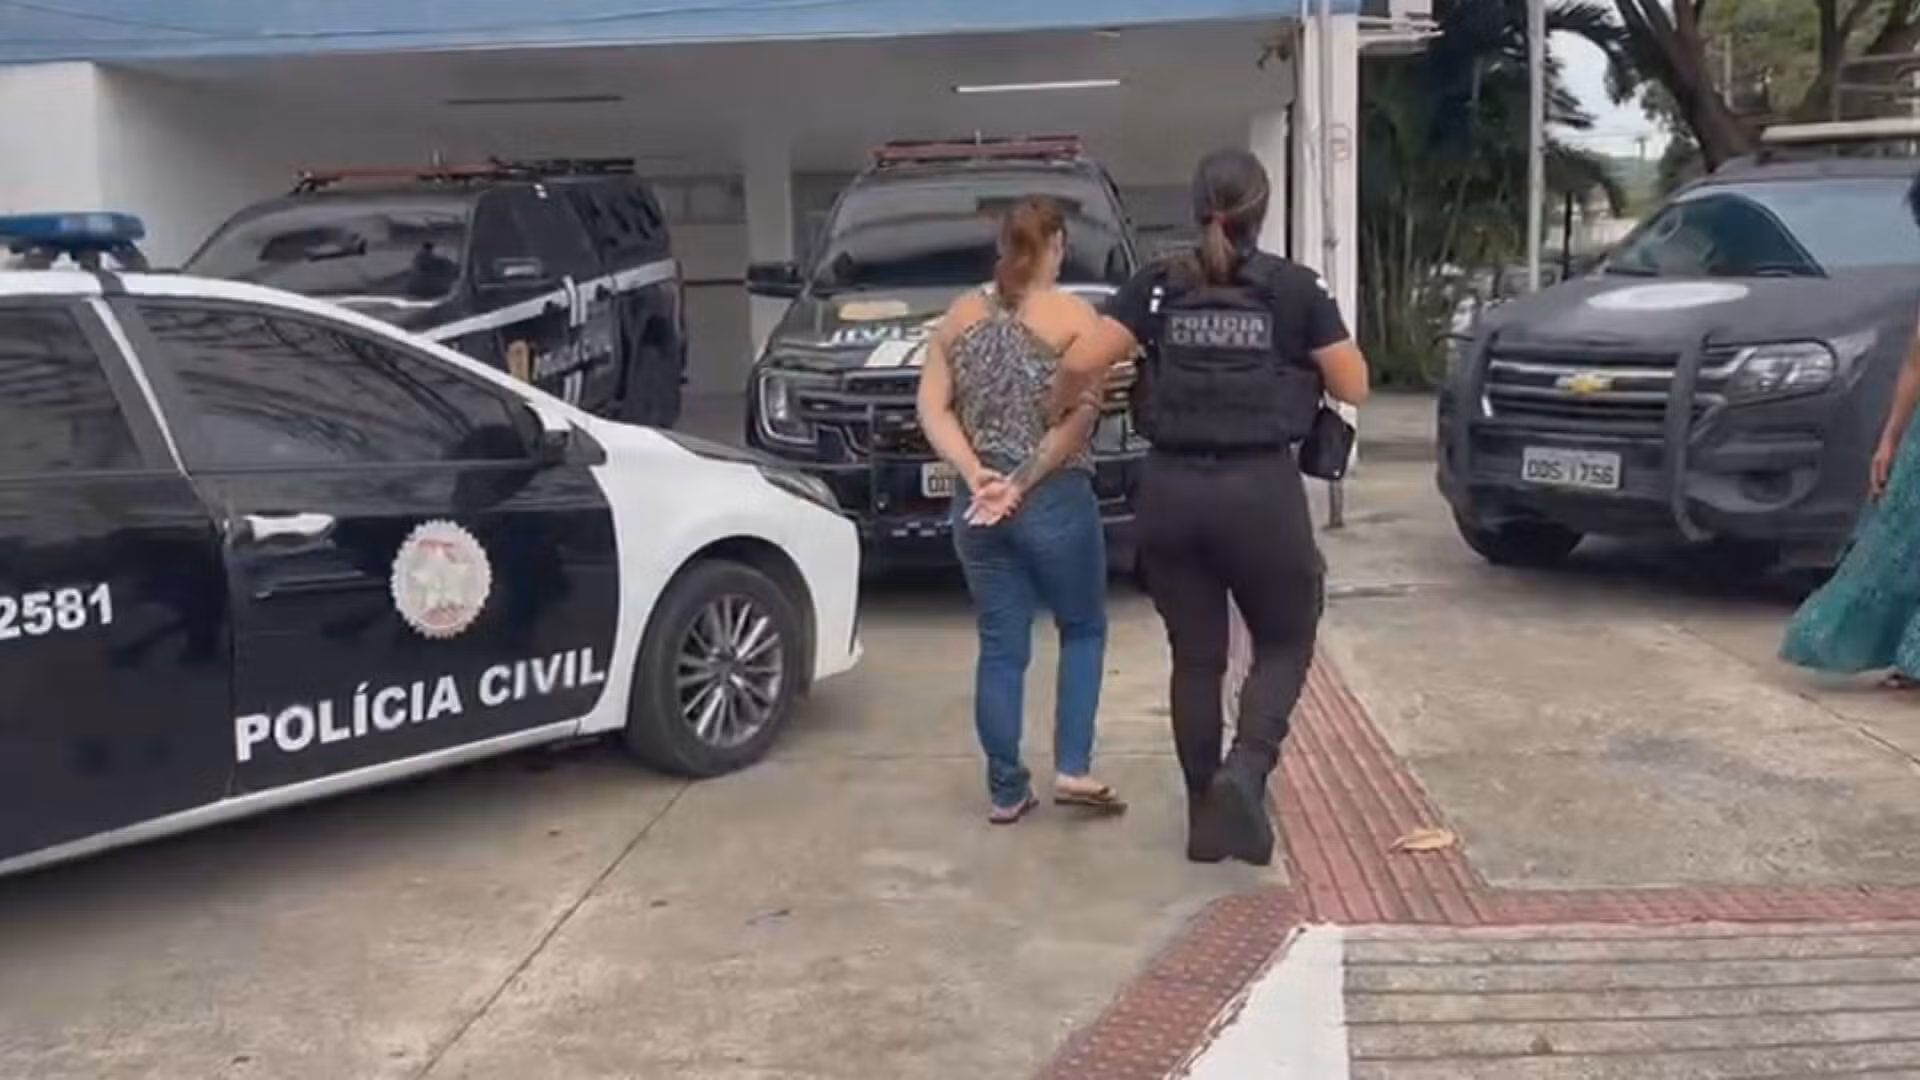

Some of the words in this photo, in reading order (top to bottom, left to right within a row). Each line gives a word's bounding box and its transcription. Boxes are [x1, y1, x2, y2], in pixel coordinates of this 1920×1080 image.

[0, 582, 112, 640] 2581
[234, 680, 463, 763] POLÍCIA
[478, 647, 604, 706] CIVIL
